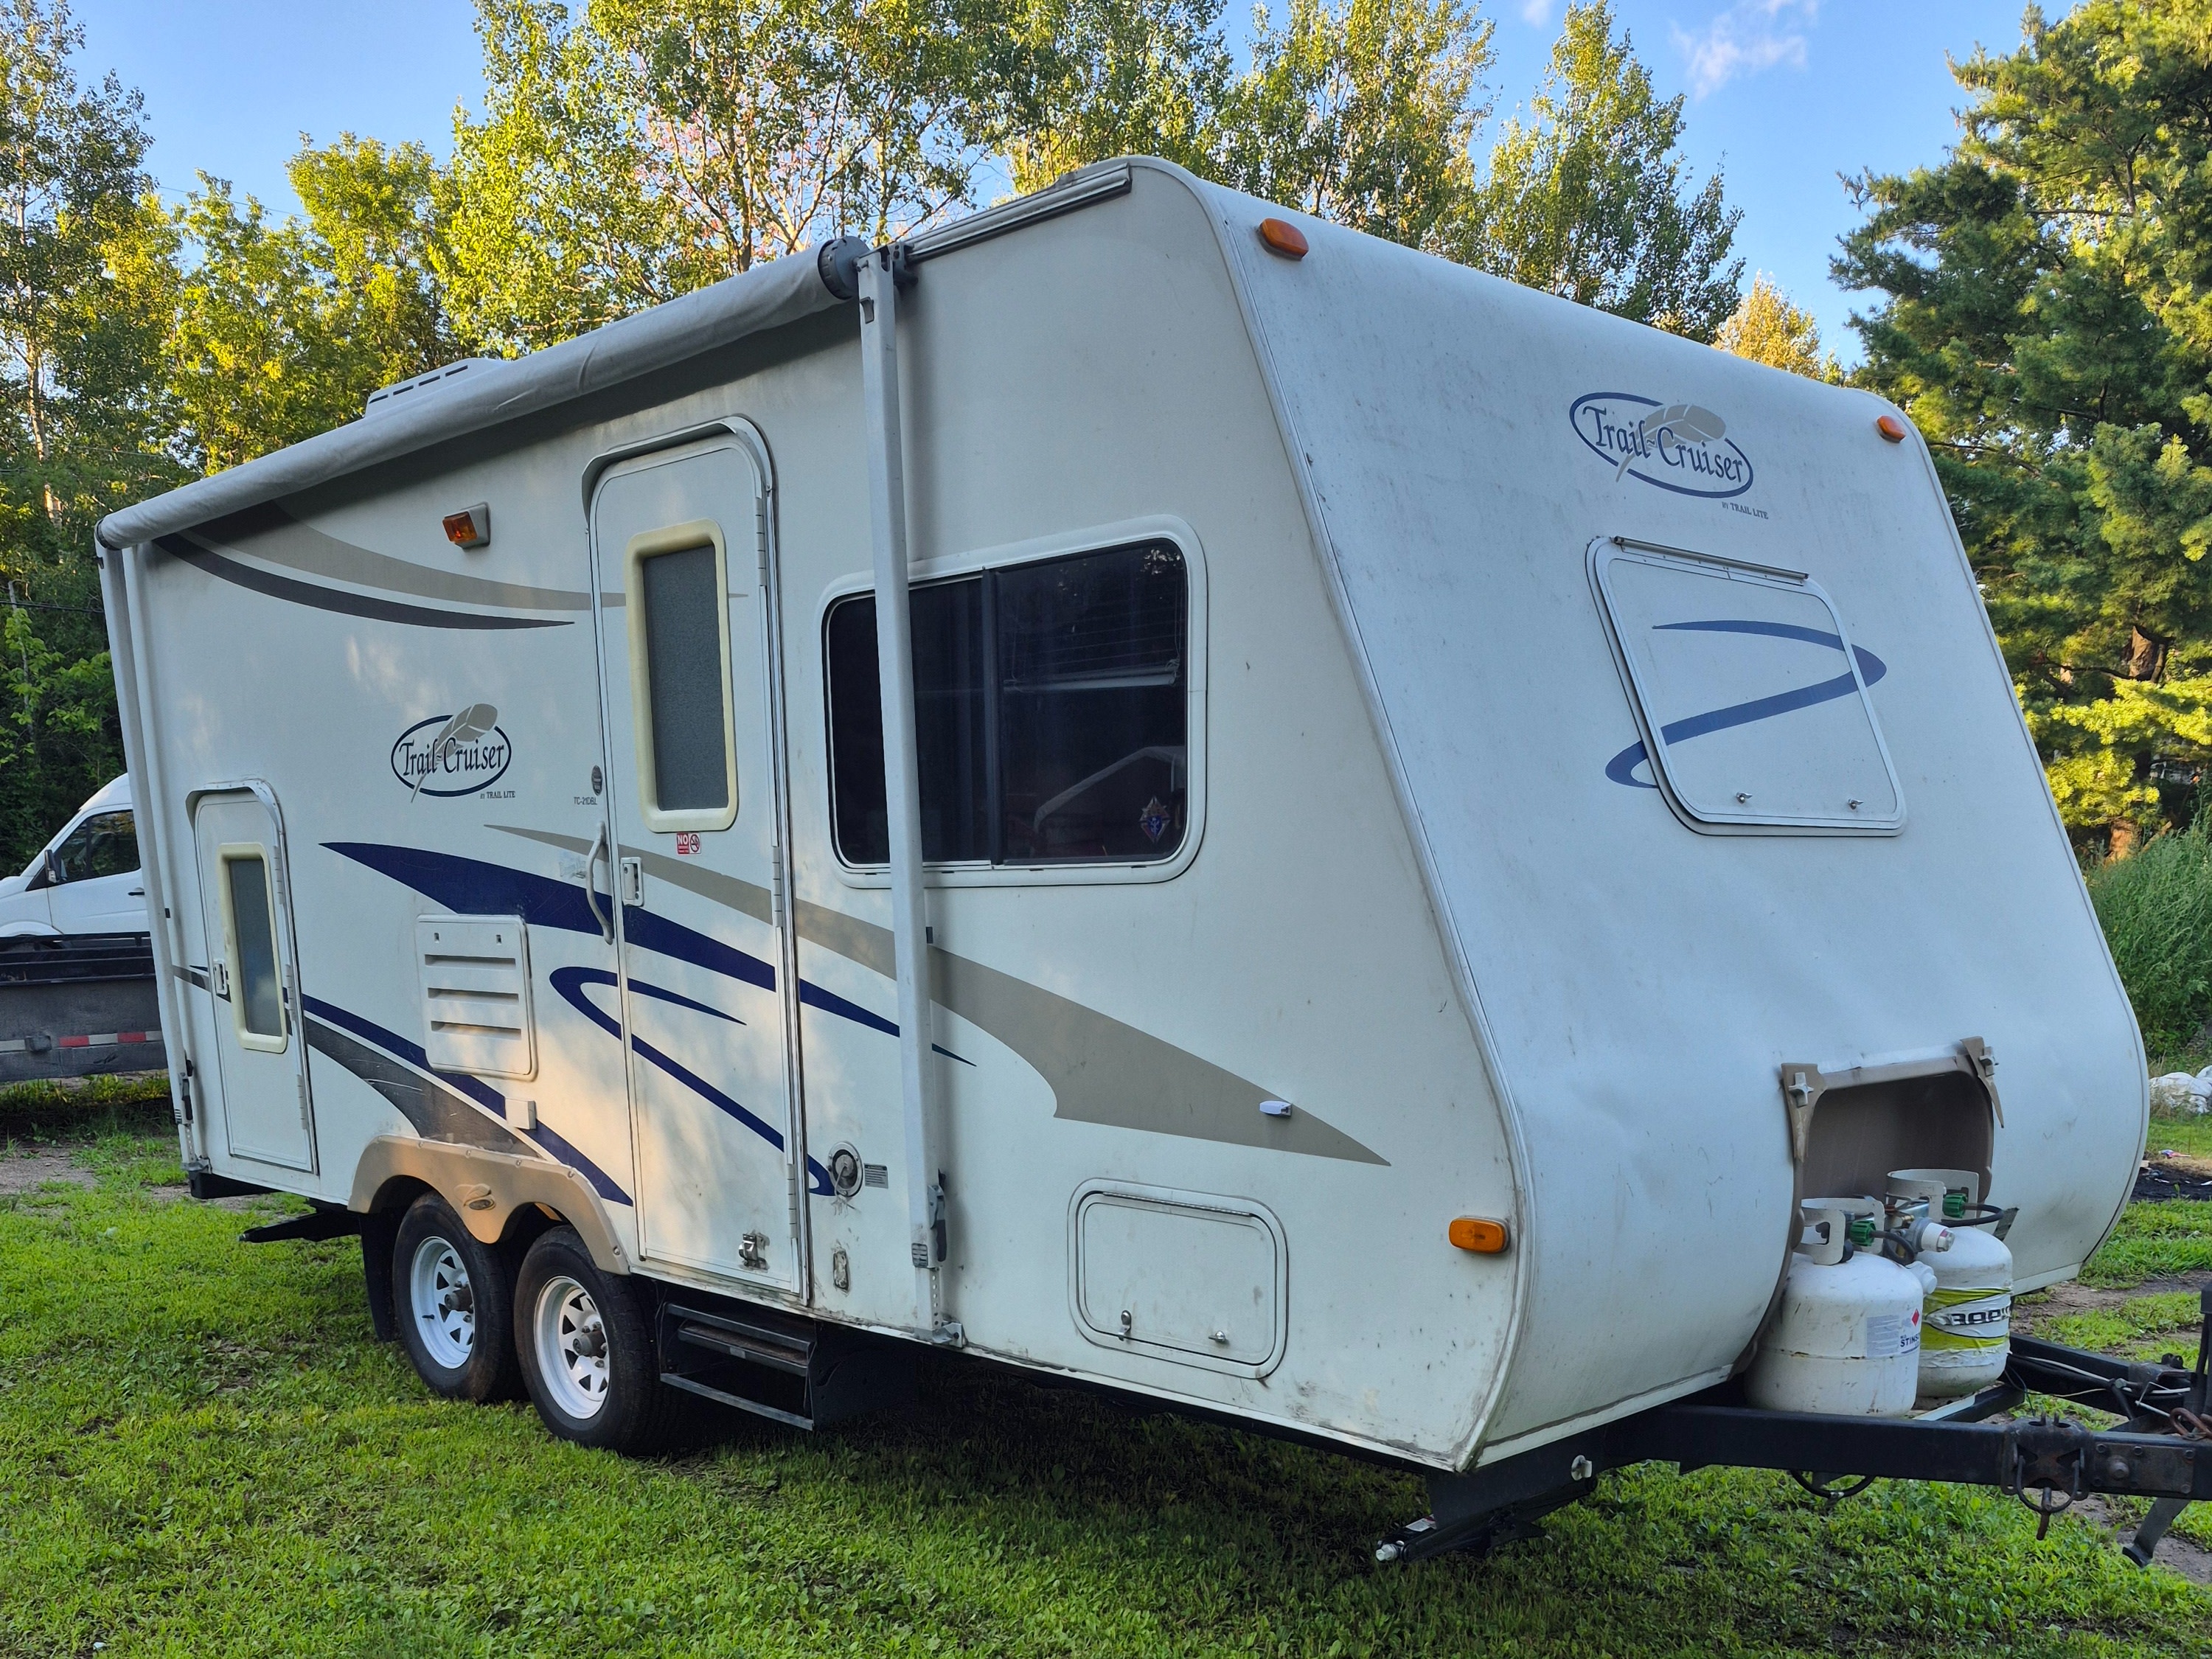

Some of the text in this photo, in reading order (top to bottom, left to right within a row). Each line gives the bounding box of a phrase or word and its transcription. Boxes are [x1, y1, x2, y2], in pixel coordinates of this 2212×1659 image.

[1730, 502, 1752, 515] TRAIL
[1753, 508, 1769, 520] LITE
[678, 834, 689, 845] NO
